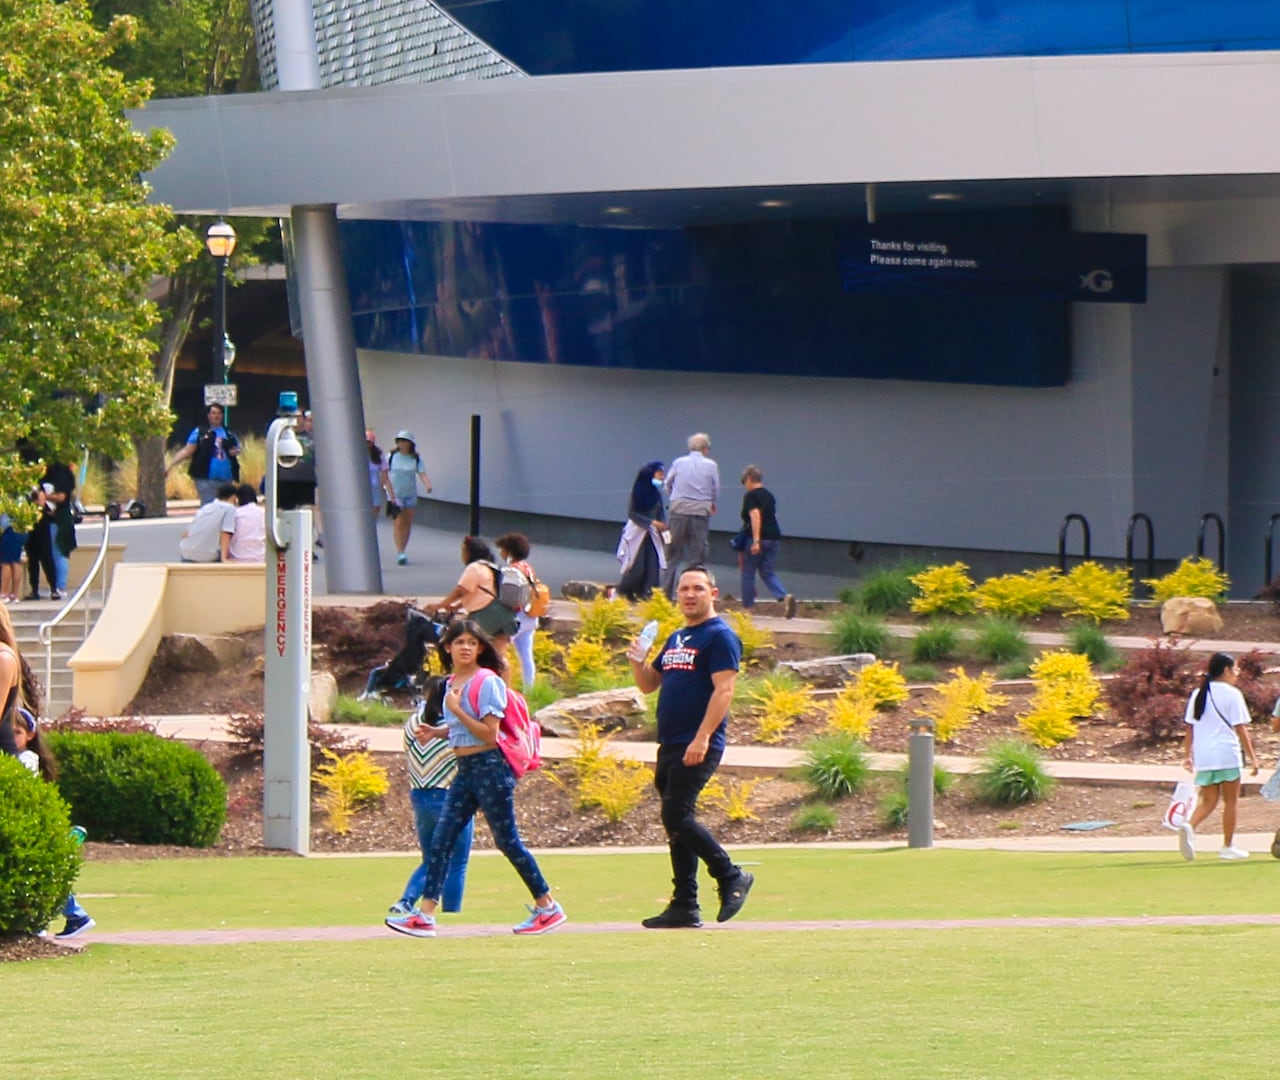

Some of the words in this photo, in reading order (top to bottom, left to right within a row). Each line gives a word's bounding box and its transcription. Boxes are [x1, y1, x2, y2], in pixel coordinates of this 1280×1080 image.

[871, 240, 901, 251] Thanks
[903, 241, 915, 251] for
[917, 243, 948, 255] visiting.
[870, 254, 901, 265] Please
[903, 257, 926, 266] come
[928, 258, 952, 269] again
[276, 553, 287, 657] EMERGENCY
